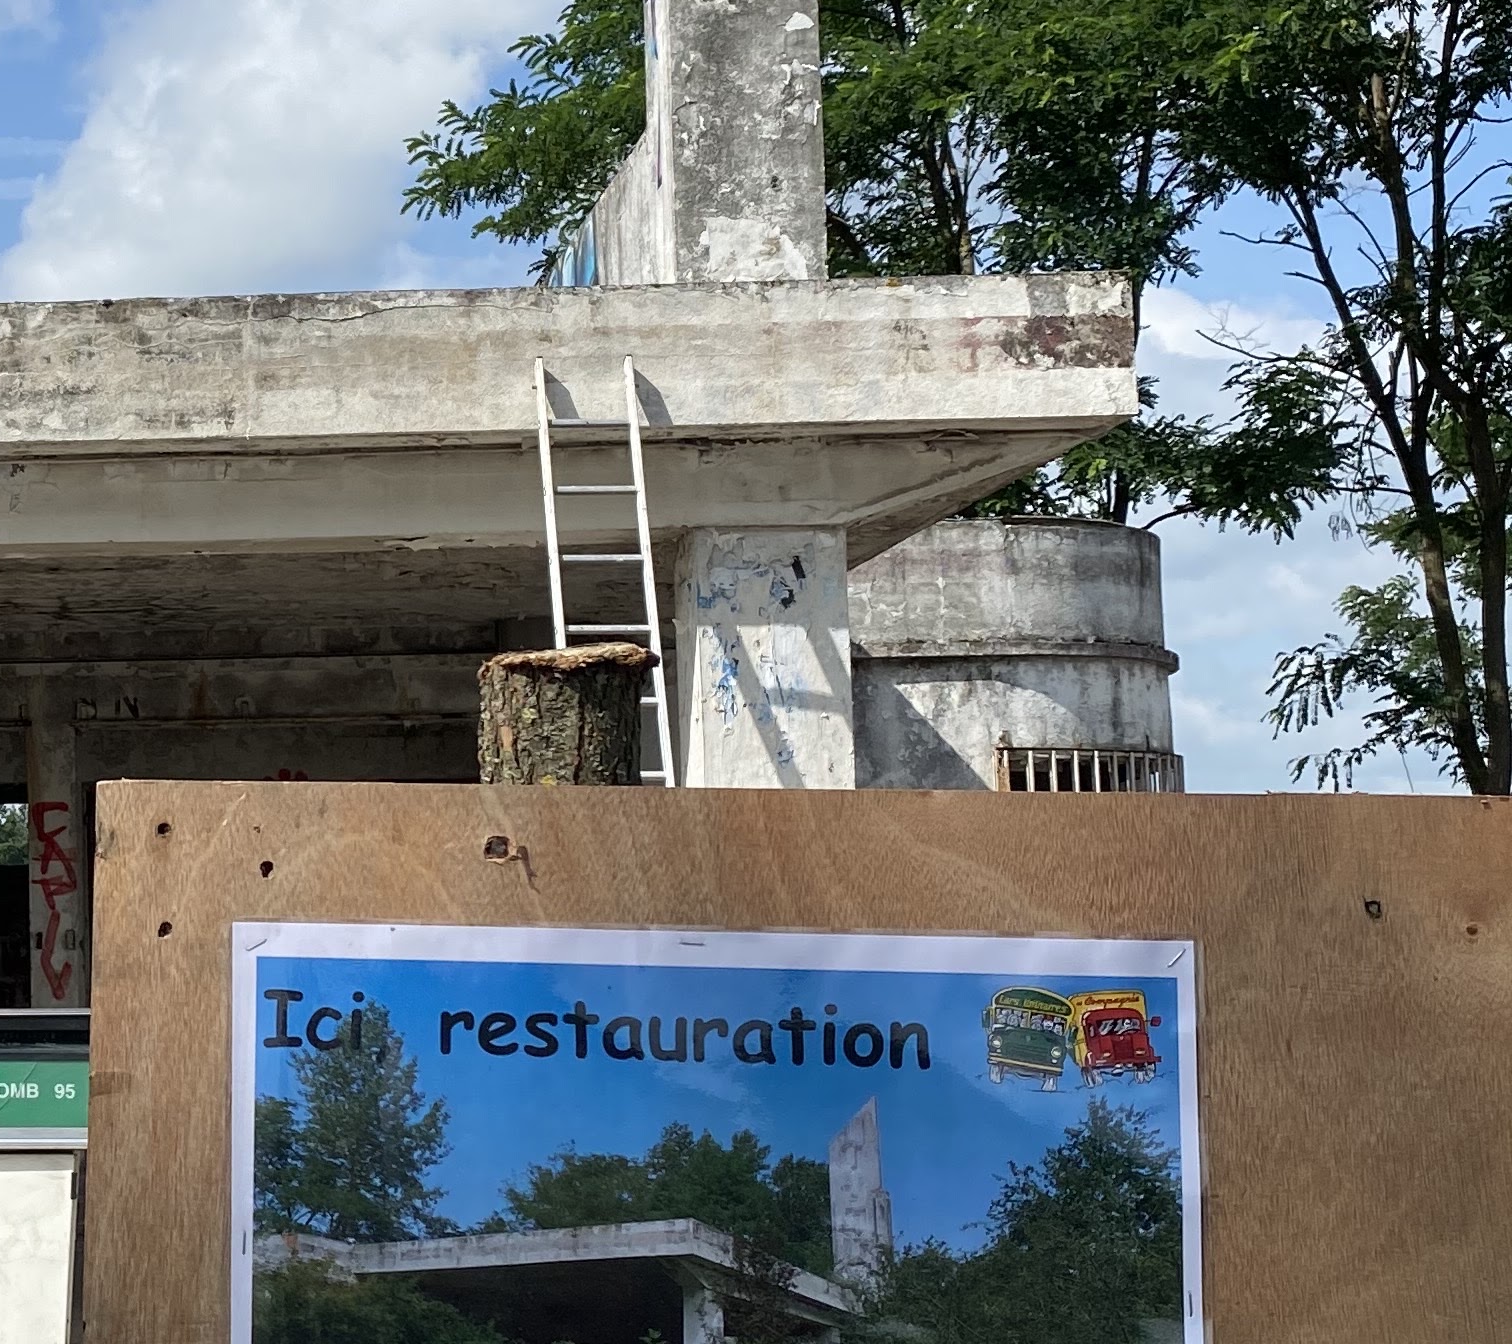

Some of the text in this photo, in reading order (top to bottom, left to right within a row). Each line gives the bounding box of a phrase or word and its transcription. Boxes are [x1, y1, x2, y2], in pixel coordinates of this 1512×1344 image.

[1084, 992, 1140, 1009] Compagnie
[263, 988, 935, 1069] Ici restauration
[54, 1083, 76, 1100] 95
